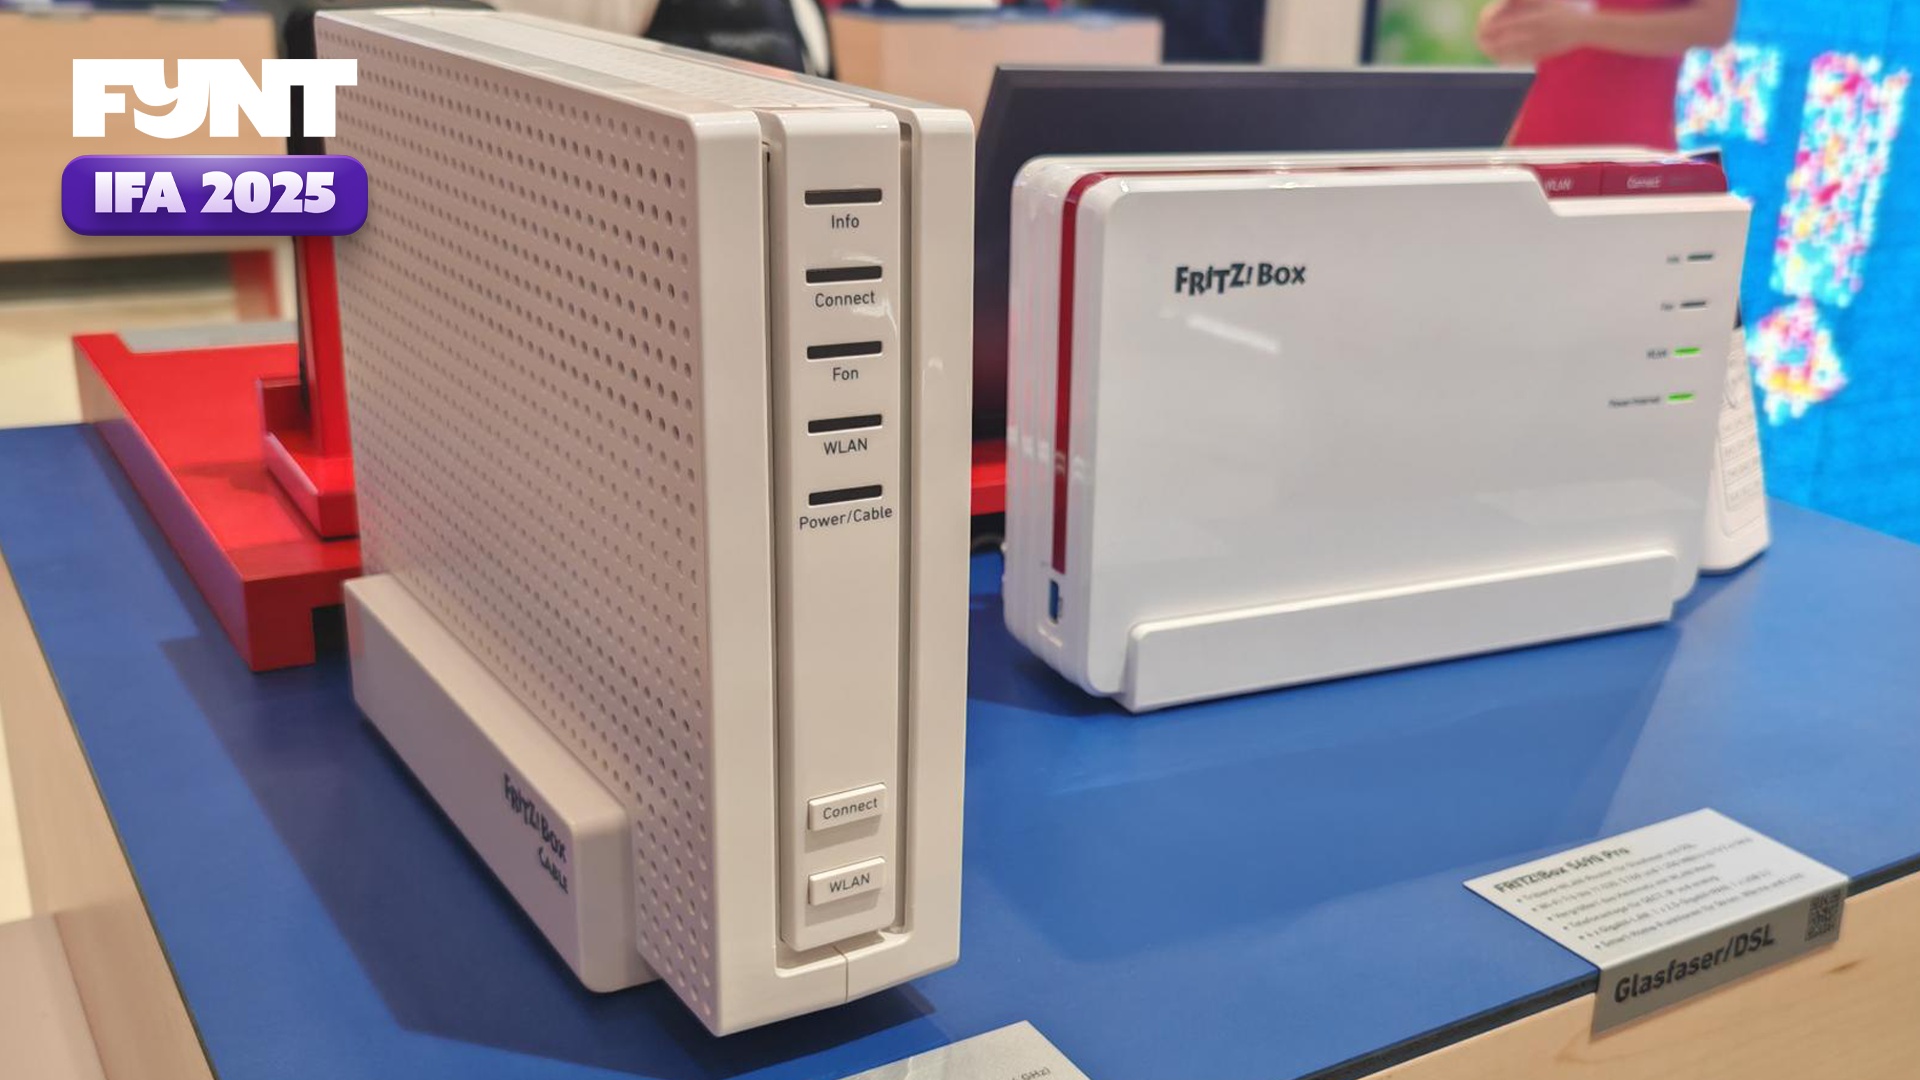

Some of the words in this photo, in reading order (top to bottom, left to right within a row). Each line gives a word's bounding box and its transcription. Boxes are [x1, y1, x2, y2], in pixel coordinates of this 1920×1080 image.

[831, 215, 860, 229] Info
[815, 291, 875, 308] Connect
[833, 367, 859, 381] Fon
[824, 438, 868, 455] WLAN
[800, 506, 893, 530] Power/Cable
[823, 798, 878, 820] Connect
[829, 873, 870, 893] WLAN
[1614, 923, 1776, 1003] Glasfaser/DSL
